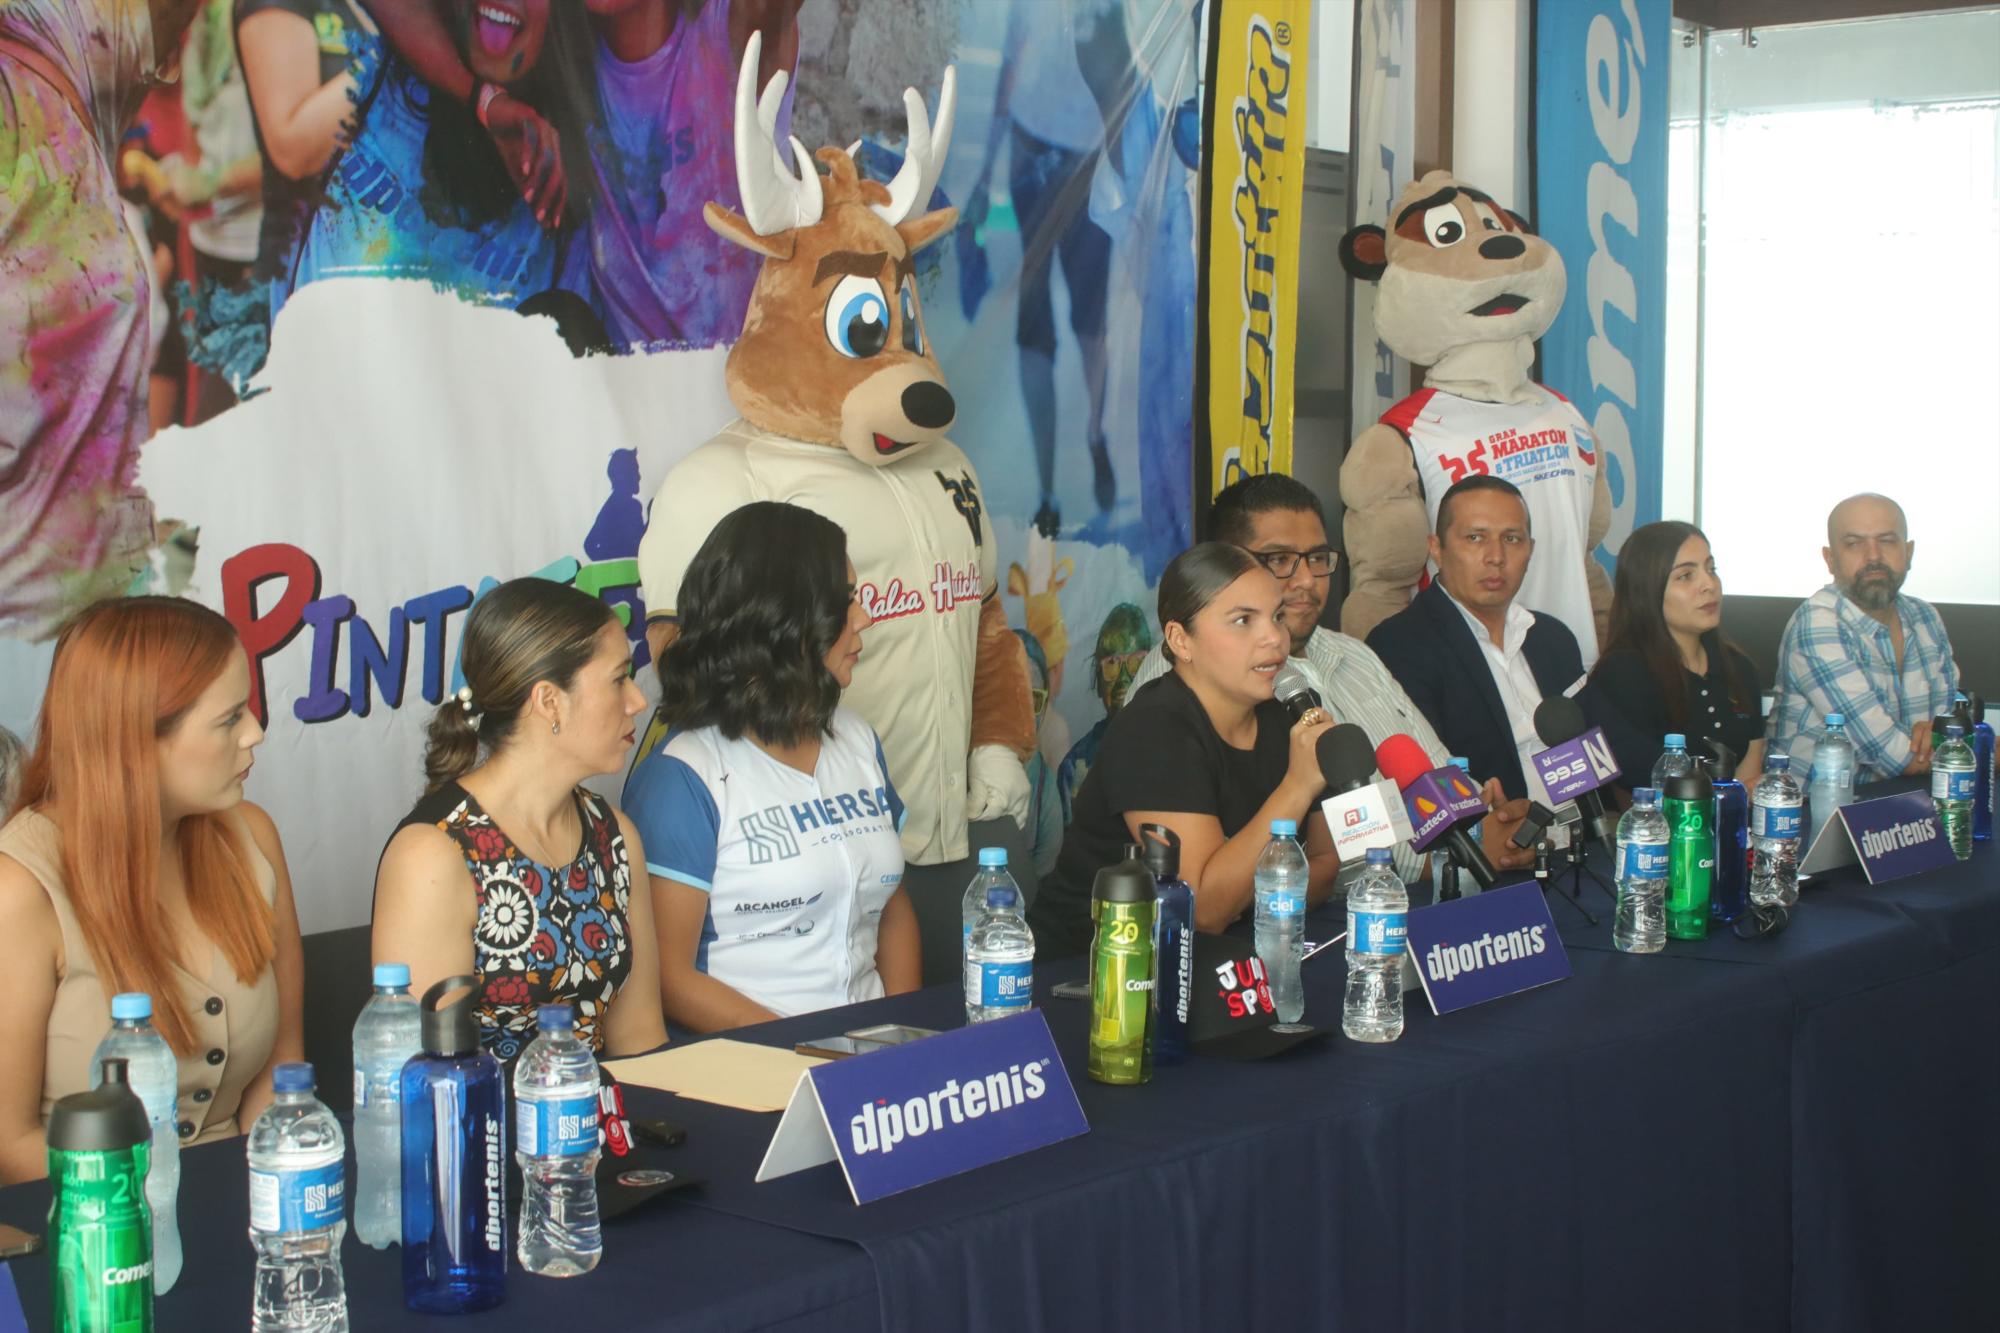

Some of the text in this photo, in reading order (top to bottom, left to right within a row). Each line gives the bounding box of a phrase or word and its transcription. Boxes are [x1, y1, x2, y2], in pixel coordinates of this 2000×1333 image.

[861, 578, 925, 622] Salsa
[1544, 758, 1587, 787] 99.5
[1419, 809, 1449, 836] azteca
[1679, 814, 1703, 830] 20
[1861, 818, 1937, 859] dportenis
[734, 896, 805, 912] ARCANGEL
[1269, 898, 1294, 913] ciel
[1109, 920, 1139, 943] 20
[1426, 924, 1546, 982] dportenis
[1176, 927, 1190, 1024] dportenis
[850, 1060, 1047, 1155] dportenis
[485, 1118, 501, 1251] dportenis
